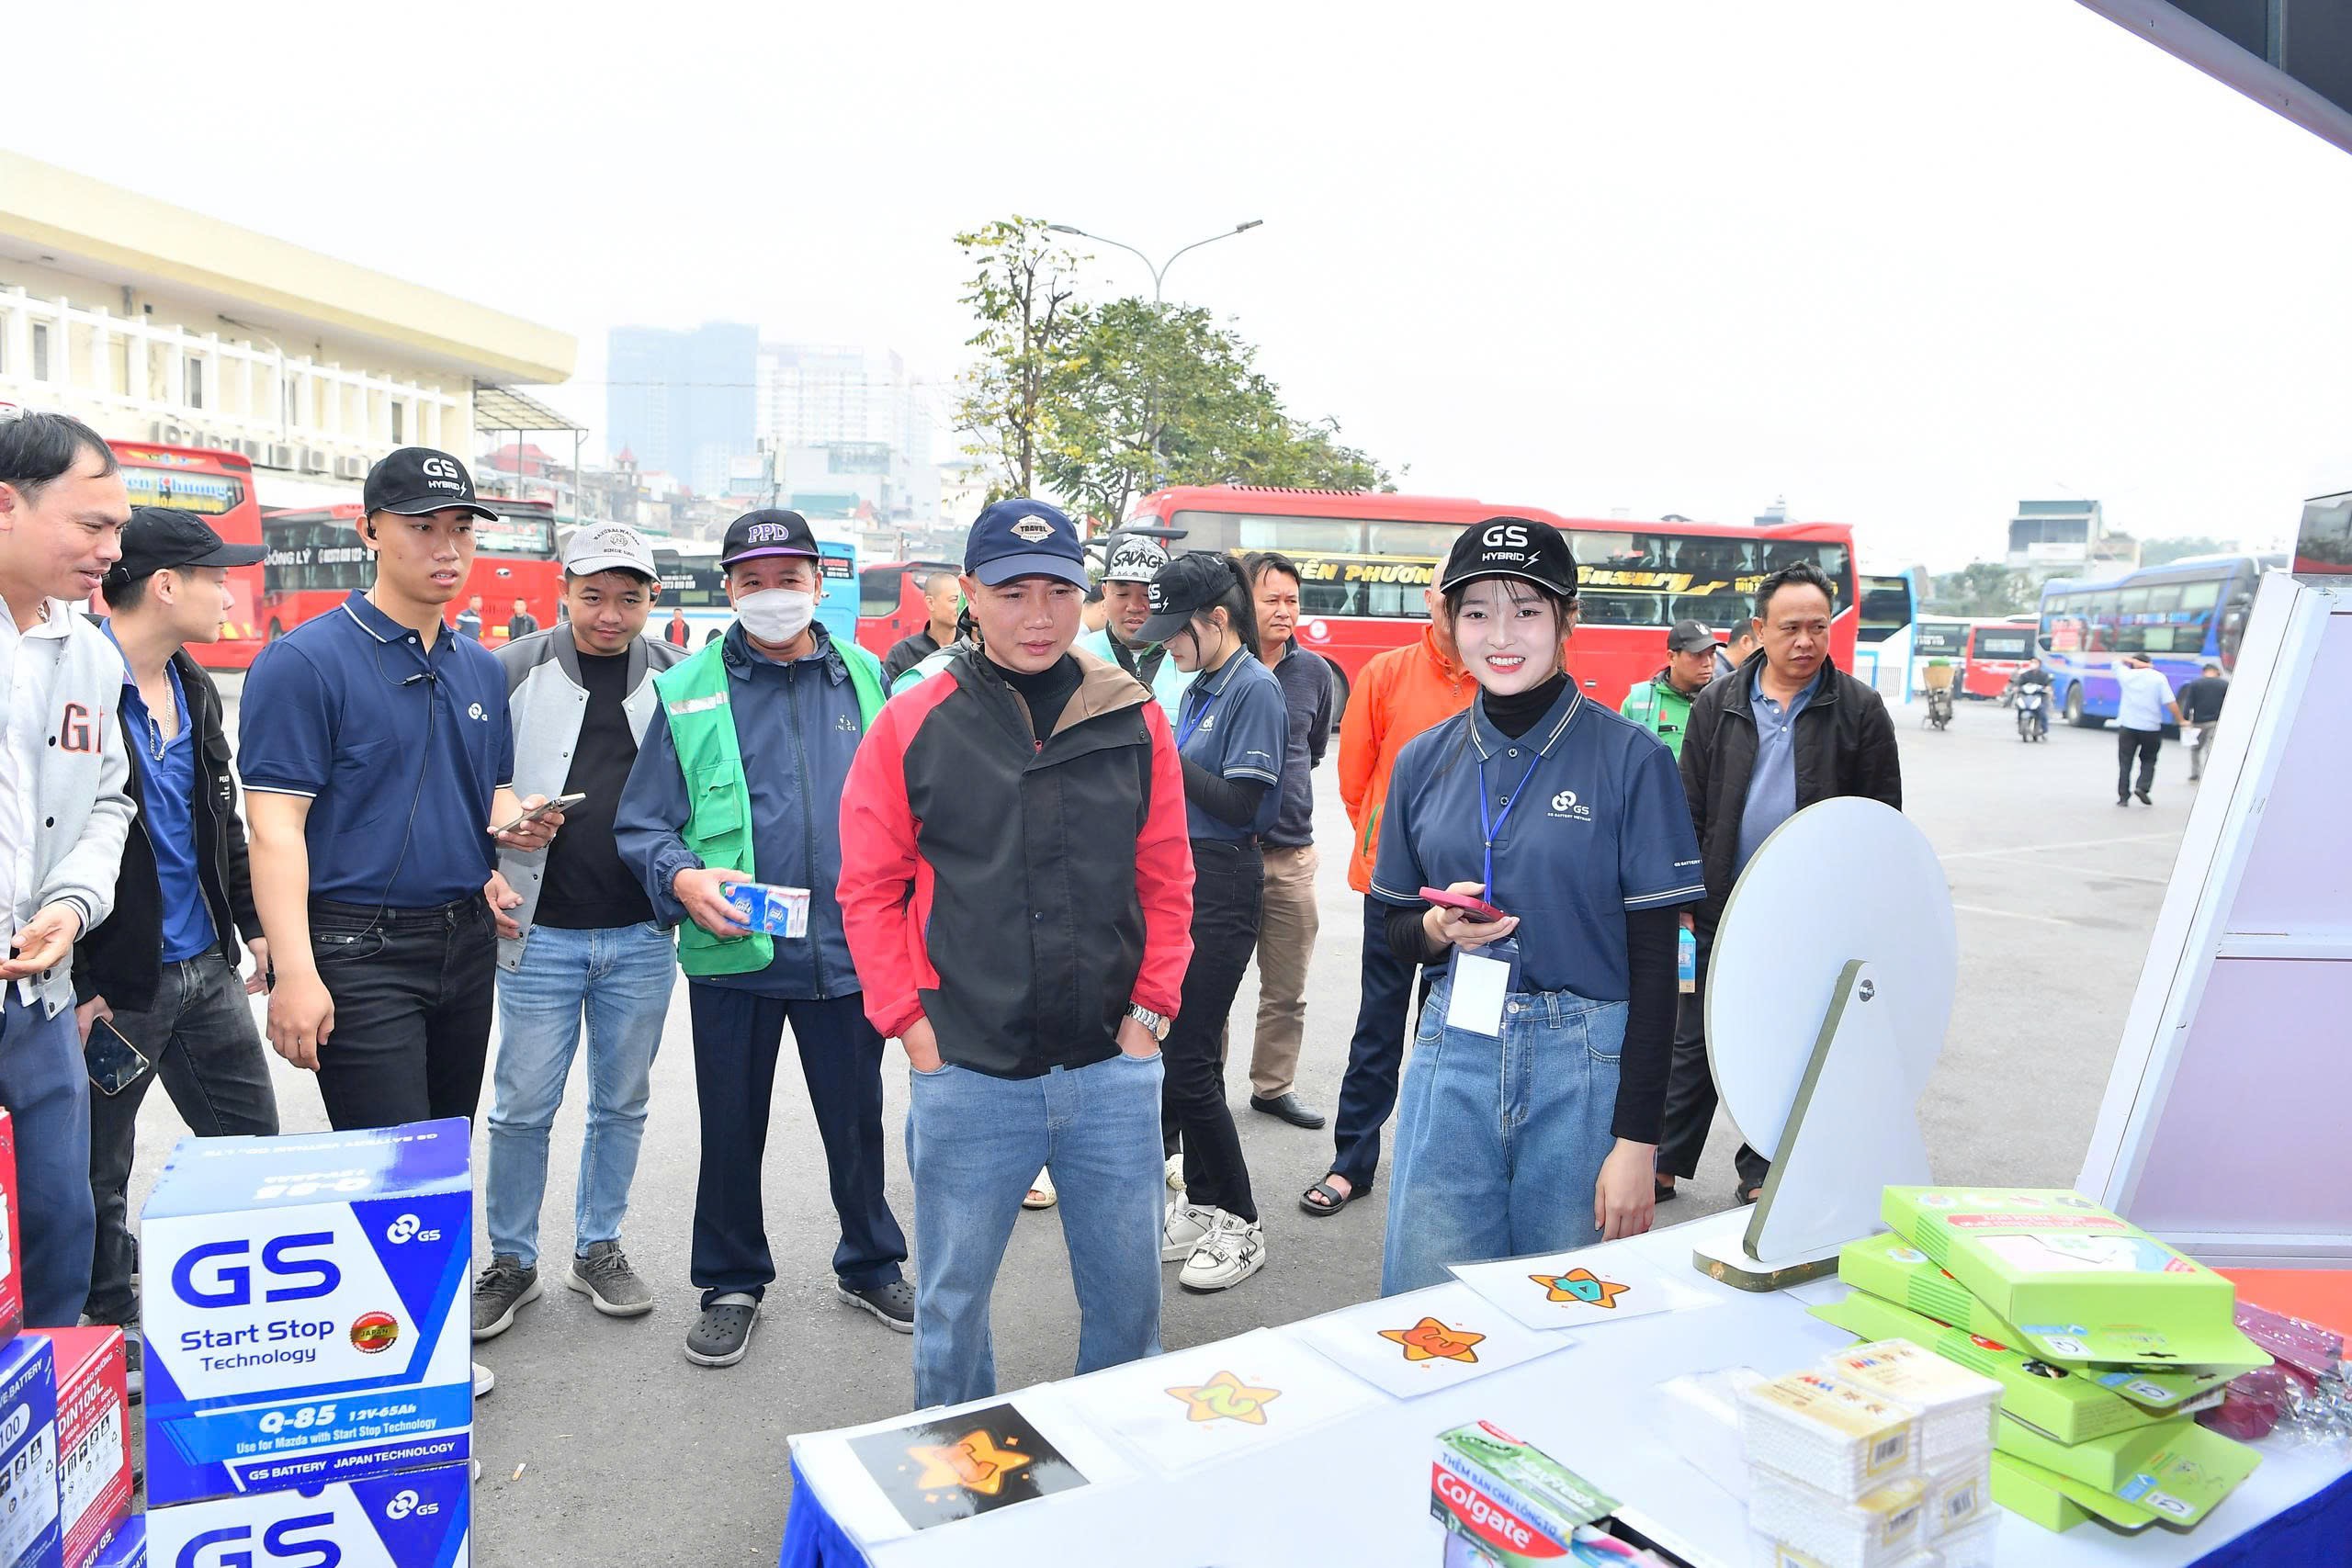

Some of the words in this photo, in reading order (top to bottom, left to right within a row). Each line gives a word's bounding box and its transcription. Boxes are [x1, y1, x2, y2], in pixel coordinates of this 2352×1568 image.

[423, 457, 458, 479] GS
[428, 480, 460, 491] HYBRID
[748, 522, 789, 544] PPD
[1020, 525, 1048, 533] TRAVEL
[1482, 525, 1528, 547] GS
[1113, 551, 1164, 568] SAVAGE
[1482, 552, 1525, 561] HYBRID
[1345, 564, 1434, 585] PHƯƠN
[1573, 805, 1589, 815] GS
[417, 1229, 441, 1242] GS
[171, 1231, 341, 1309] GS
[180, 1325, 259, 1351] Start
[267, 1320, 334, 1340] Stop
[360, 1327, 389, 1337] JAPAN
[199, 1348, 316, 1371] Technology
[9, 1358, 42, 1399] BATTERY
[59, 1379, 103, 1438] DIN100L
[258, 1404, 337, 1434] Q-85
[348, 1403, 417, 1422] 12V-65Ah
[236, 1440, 257, 1455] Use
[258, 1438, 273, 1451] for
[275, 1434, 308, 1450] Mazda
[310, 1429, 332, 1444] with
[333, 1426, 357, 1441] Start
[359, 1423, 381, 1438] Stop
[383, 1416, 437, 1435] Technology
[248, 1468, 270, 1481] GS
[272, 1461, 327, 1478] BATTERY
[334, 1454, 373, 1469] JAPAN
[374, 1442, 456, 1463] TECHNOLOGY
[415, 1503, 439, 1516] GS
[1437, 1473, 1530, 1550] Colgate
[175, 1511, 342, 1568] GS
